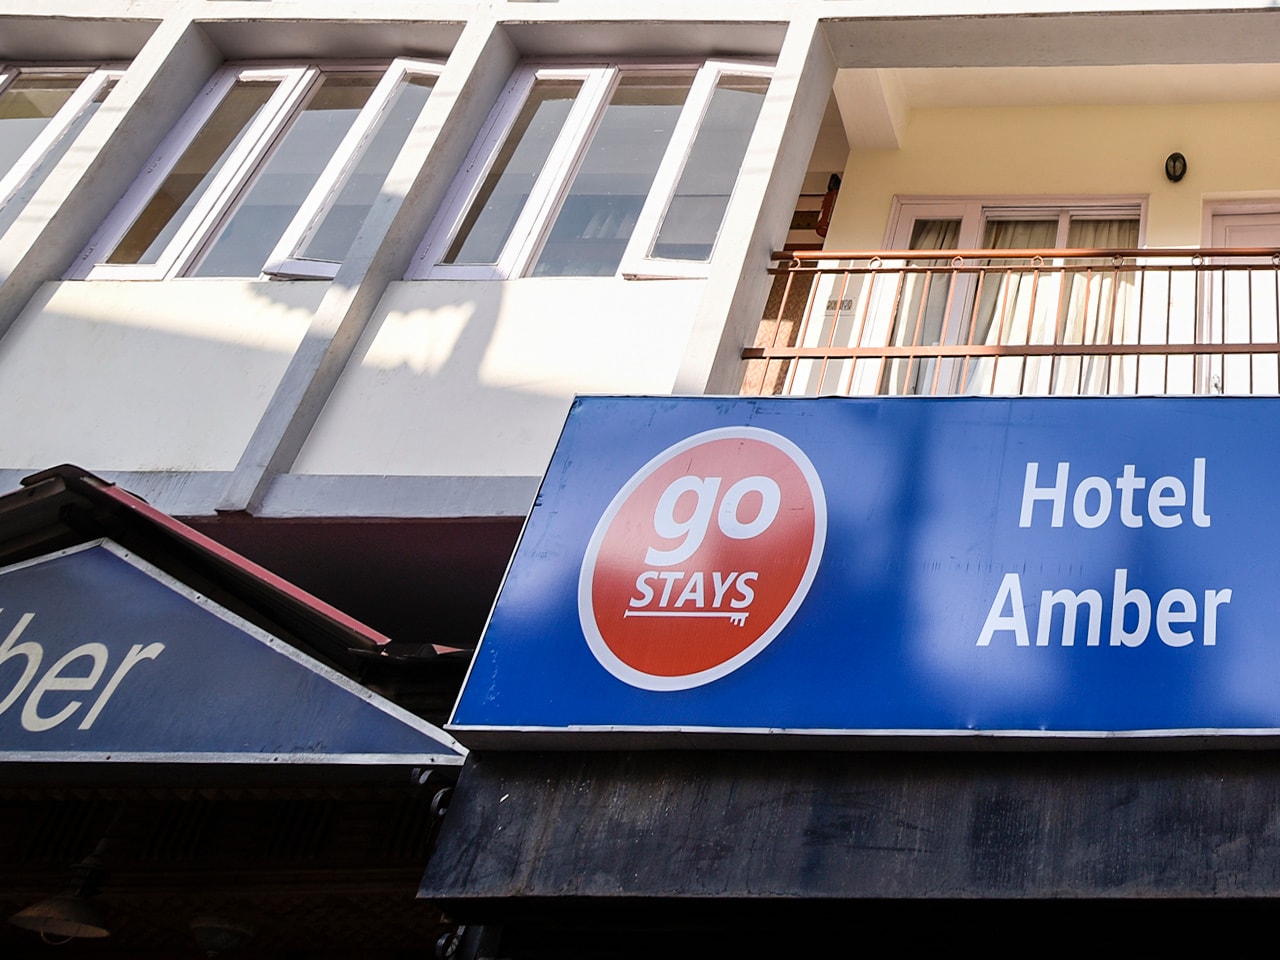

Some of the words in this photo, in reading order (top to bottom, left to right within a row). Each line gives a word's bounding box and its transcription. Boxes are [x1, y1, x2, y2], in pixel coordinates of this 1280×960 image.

[643, 474, 783, 568] go
[1018, 457, 1212, 530] Hotel
[628, 570, 760, 610] STAYS
[975, 568, 1234, 648] Amber
